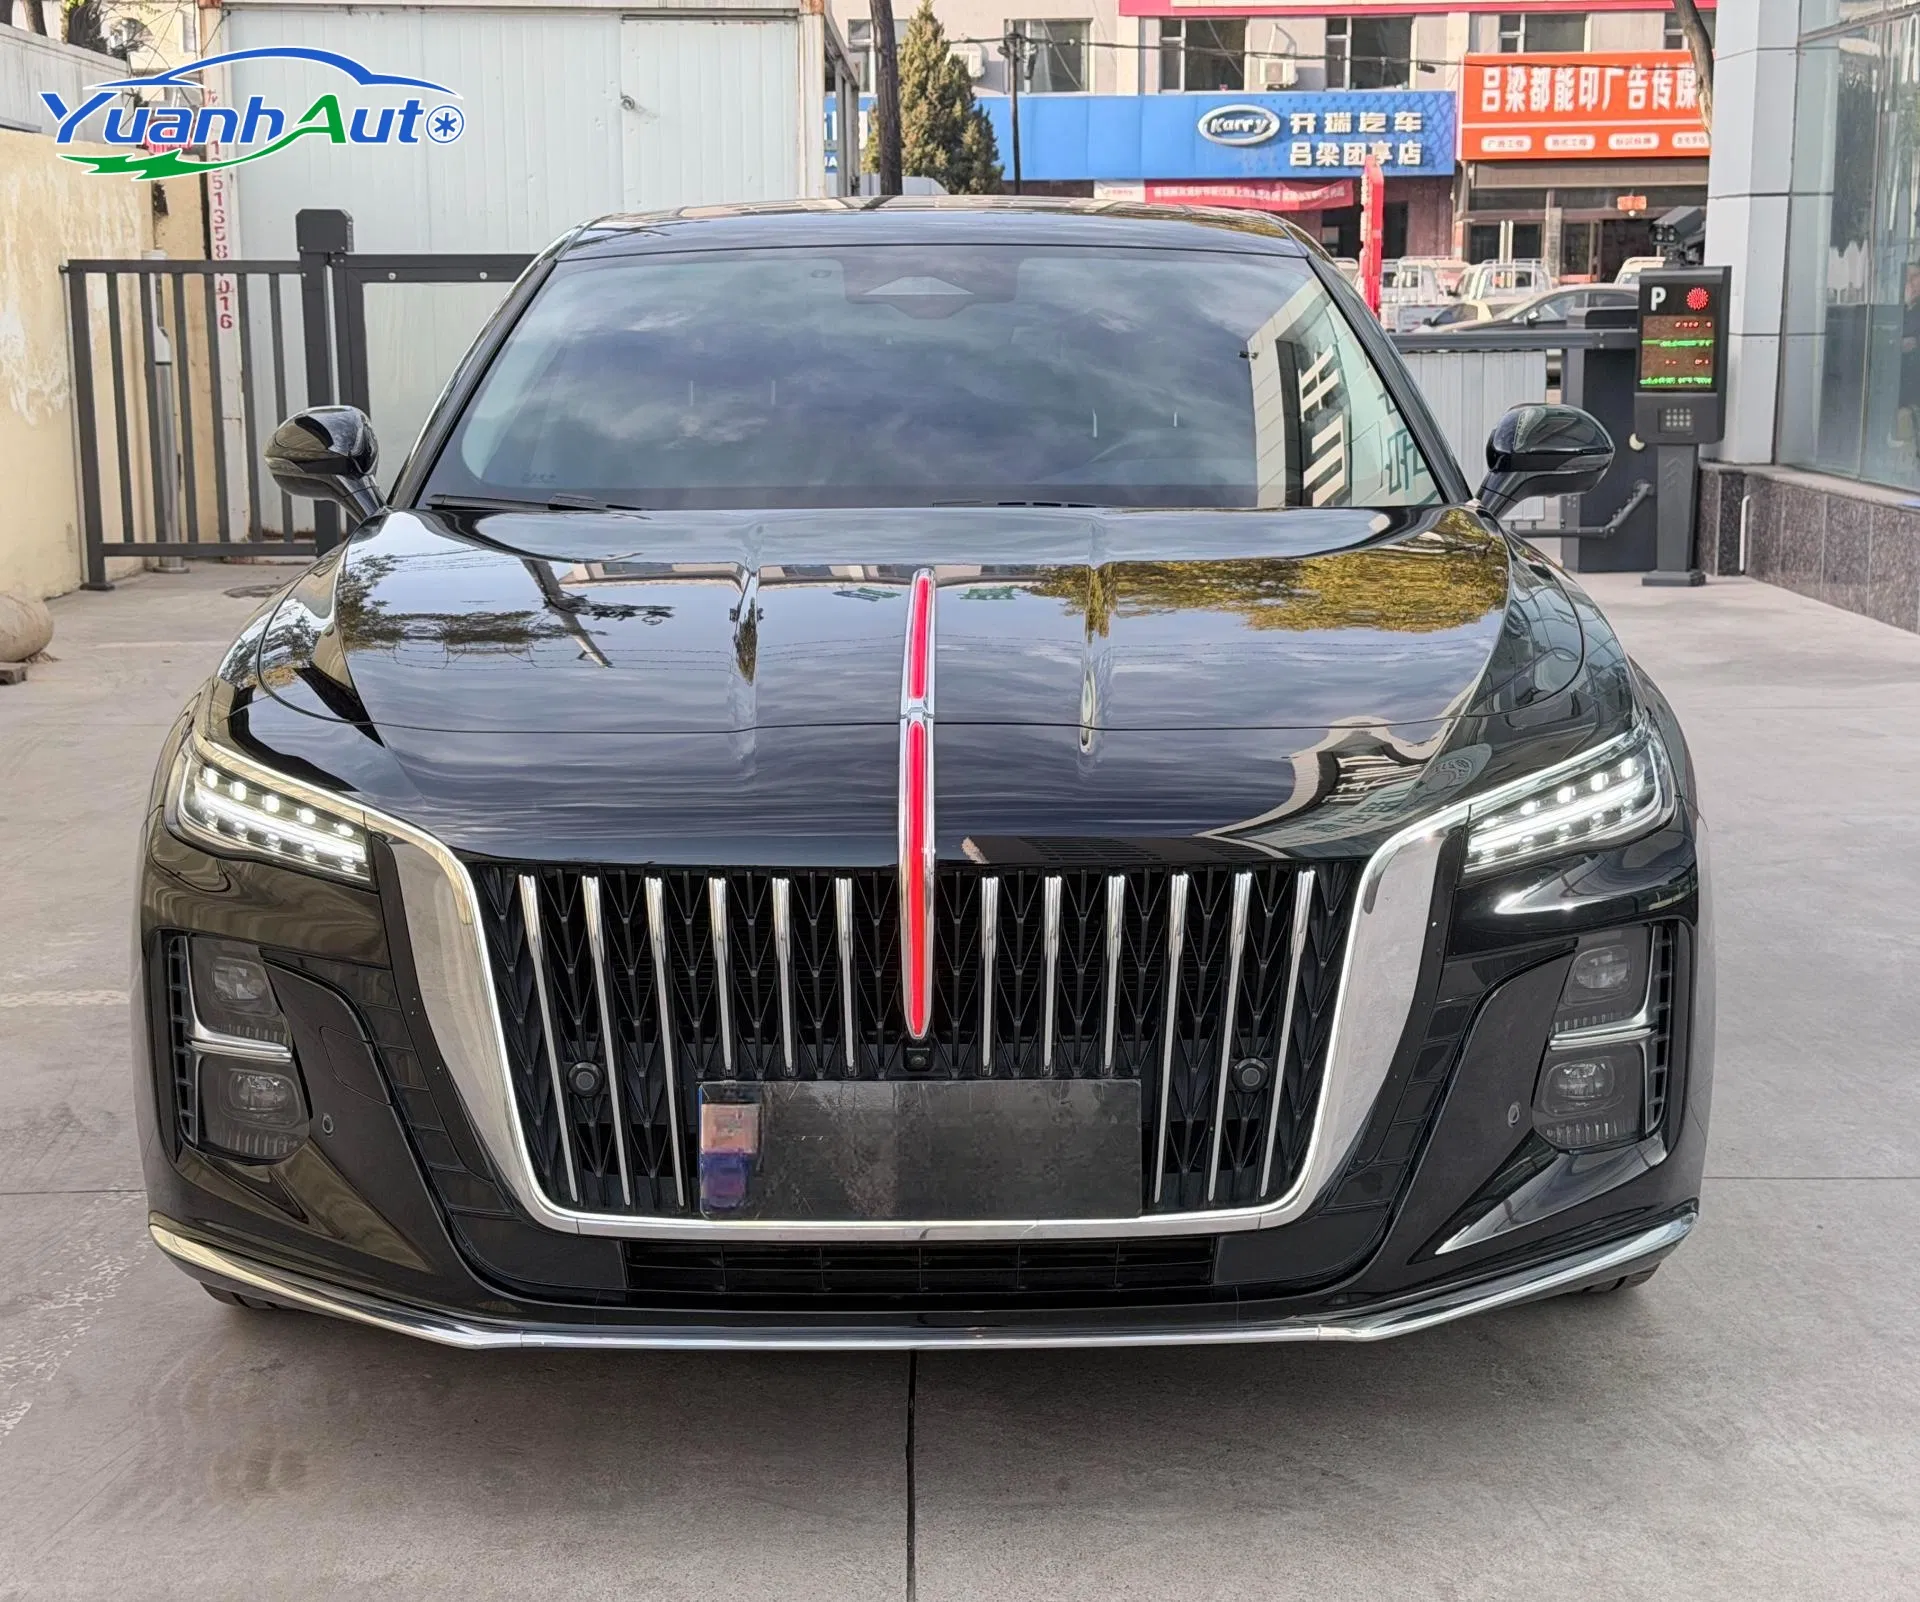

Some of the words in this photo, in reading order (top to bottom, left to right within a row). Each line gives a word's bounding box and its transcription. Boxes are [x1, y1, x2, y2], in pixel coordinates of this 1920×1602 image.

[1209, 116, 1271, 135] Karry
[1289, 111, 1424, 135] 开瑞汽车
[1650, 286, 1667, 311] P
